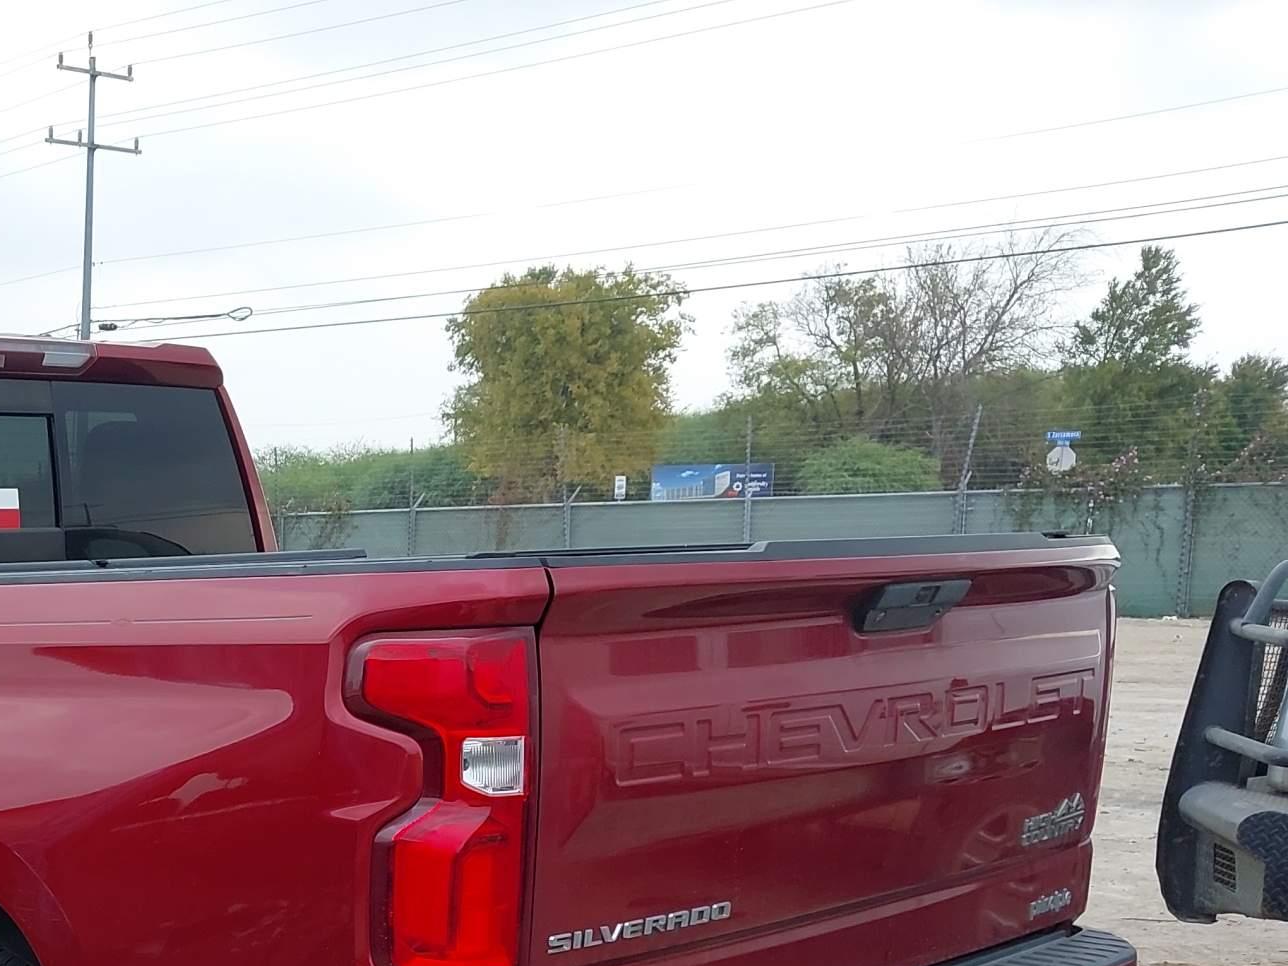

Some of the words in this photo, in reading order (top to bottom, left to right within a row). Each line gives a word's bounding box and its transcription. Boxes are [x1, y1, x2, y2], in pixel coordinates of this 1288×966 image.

[614, 667, 1097, 788] CHEVROLET
[1019, 816, 1085, 847] COUNTRY
[547, 901, 732, 954] SILVERADO
